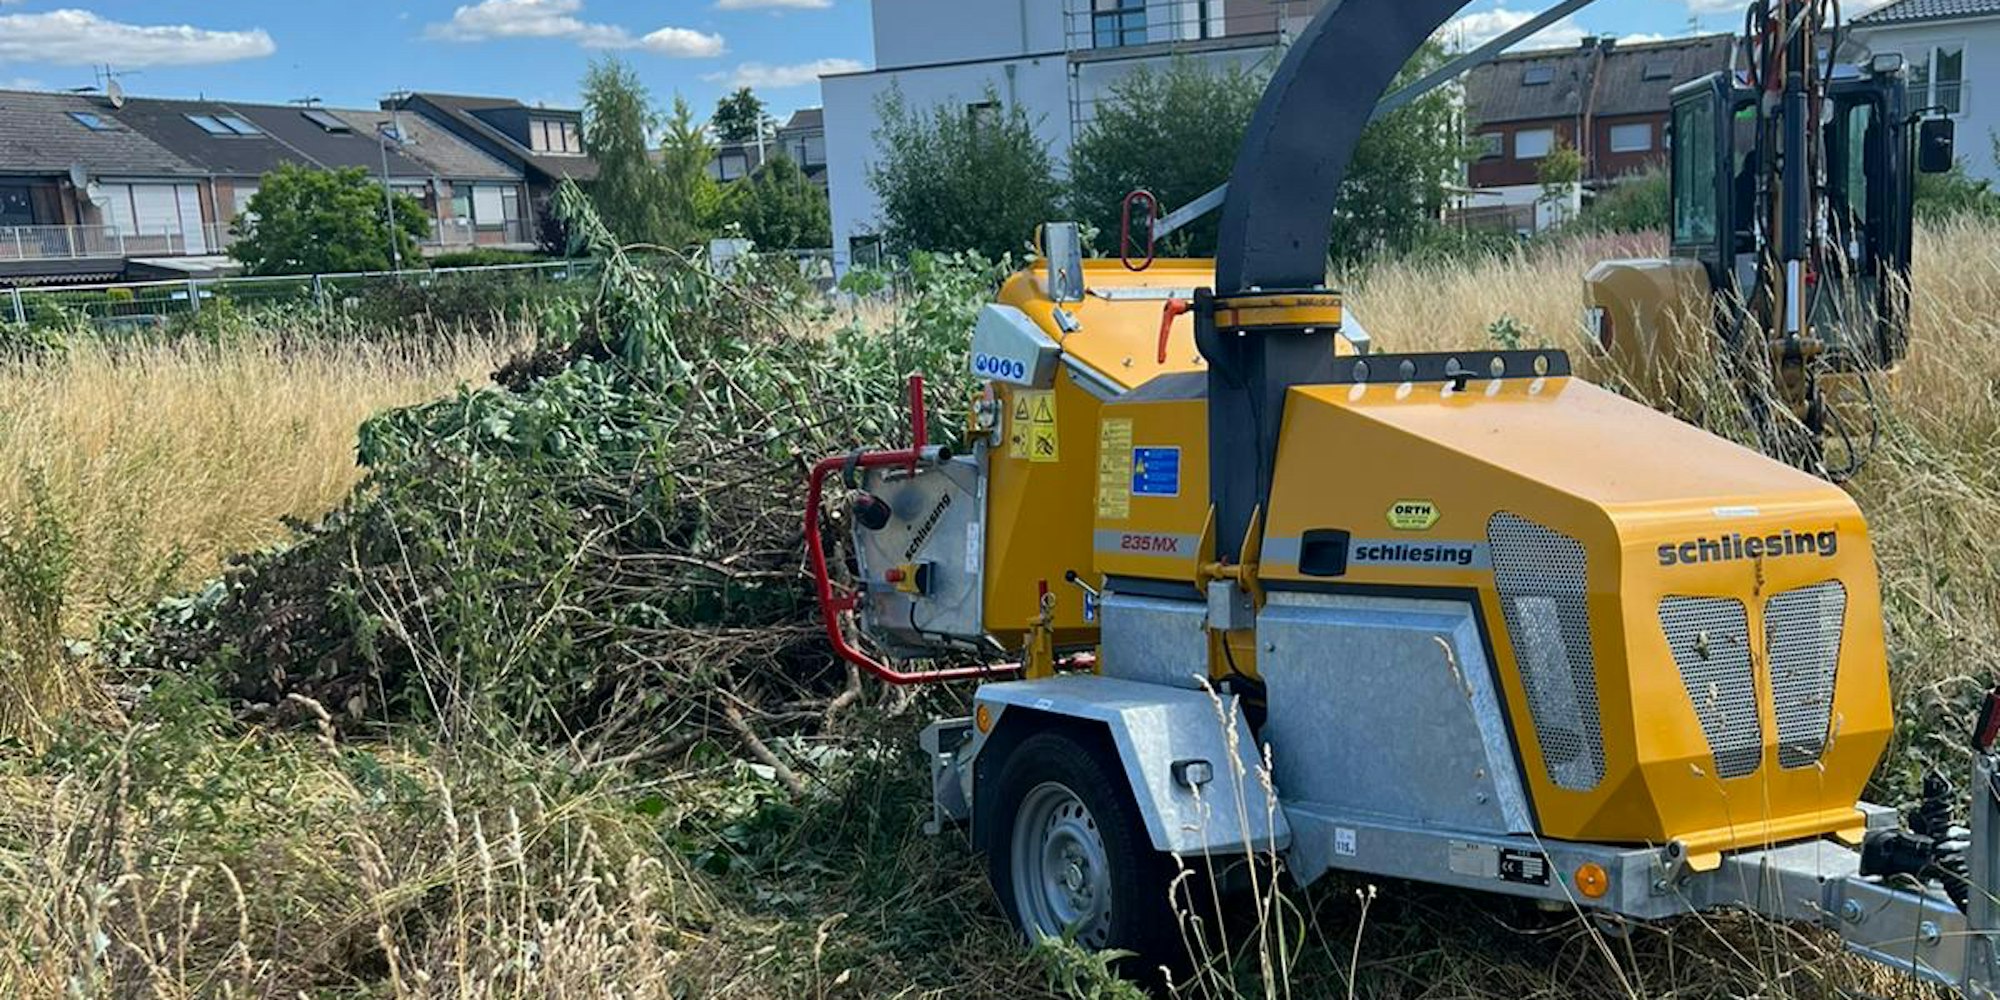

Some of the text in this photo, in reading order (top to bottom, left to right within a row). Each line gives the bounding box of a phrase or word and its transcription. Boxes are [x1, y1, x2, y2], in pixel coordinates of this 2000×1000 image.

[1395, 505, 1430, 514] ORTH
[905, 492, 951, 561] schliesing
[1355, 544, 1472, 565] schliesing
[1657, 529, 1837, 566] schliesing
